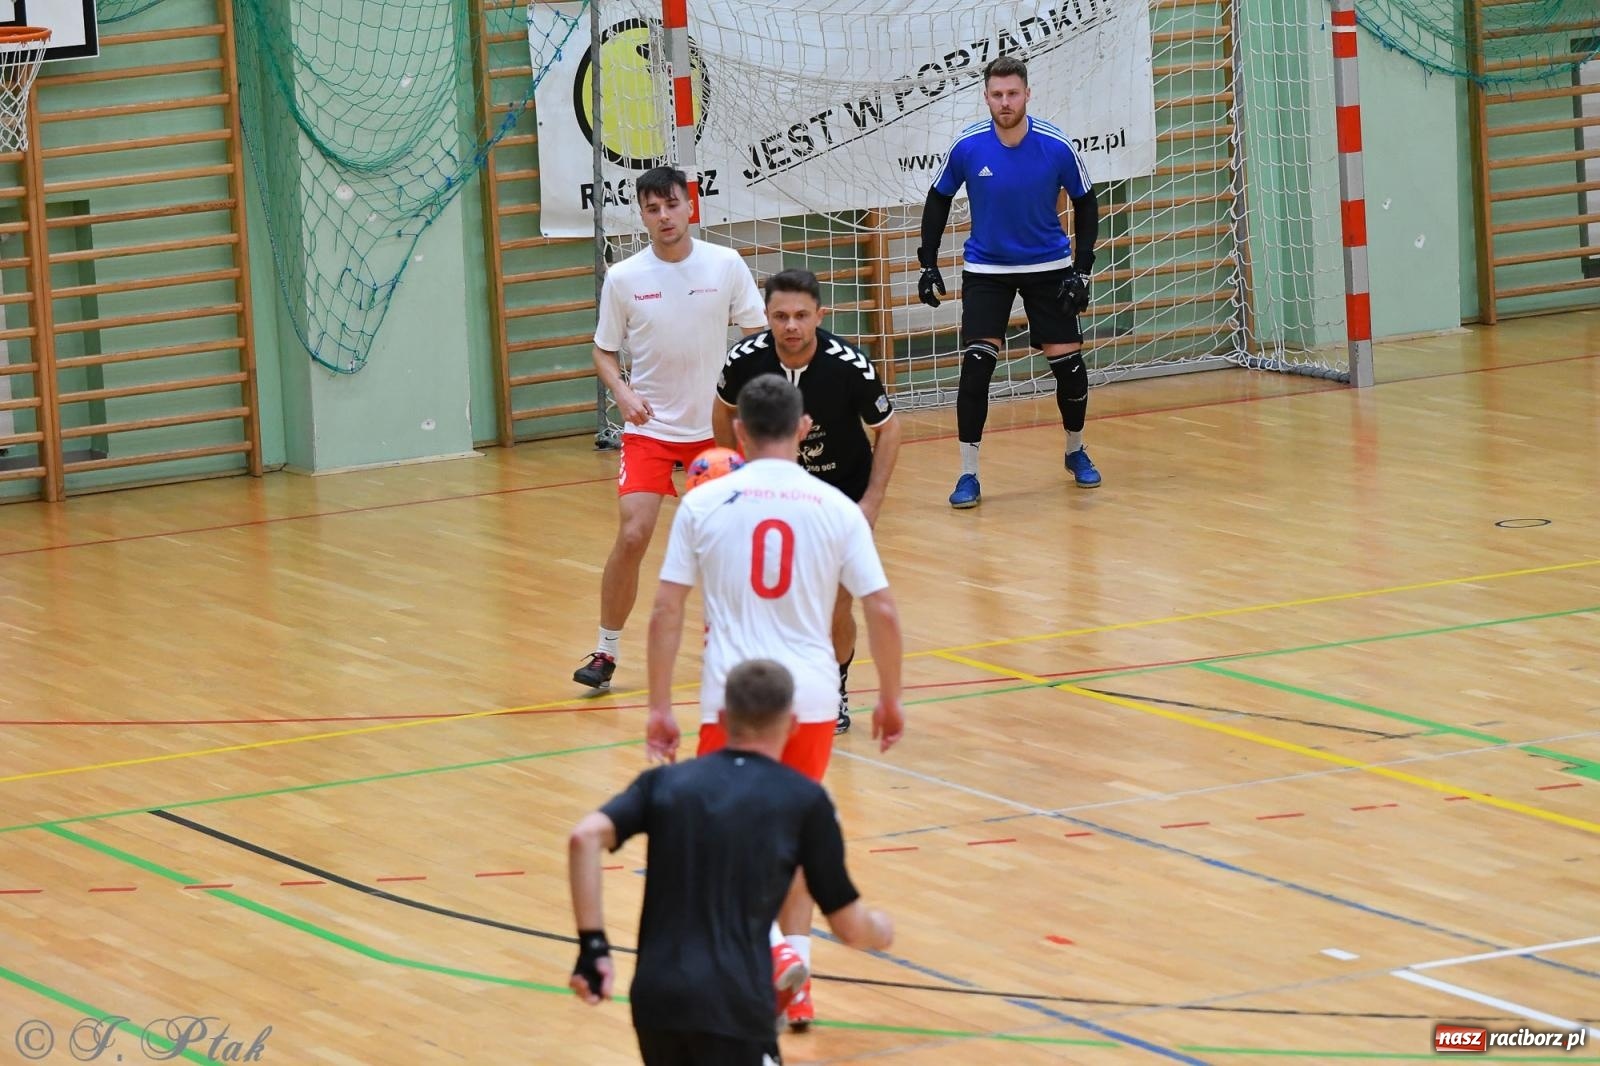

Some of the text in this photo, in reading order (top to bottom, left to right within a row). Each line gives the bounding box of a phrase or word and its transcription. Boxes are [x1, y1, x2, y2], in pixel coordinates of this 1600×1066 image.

[743, 109, 833, 180] JEST
[843, 90, 883, 131] W
[634, 291, 662, 301] hummel
[751, 518, 795, 599] 0
